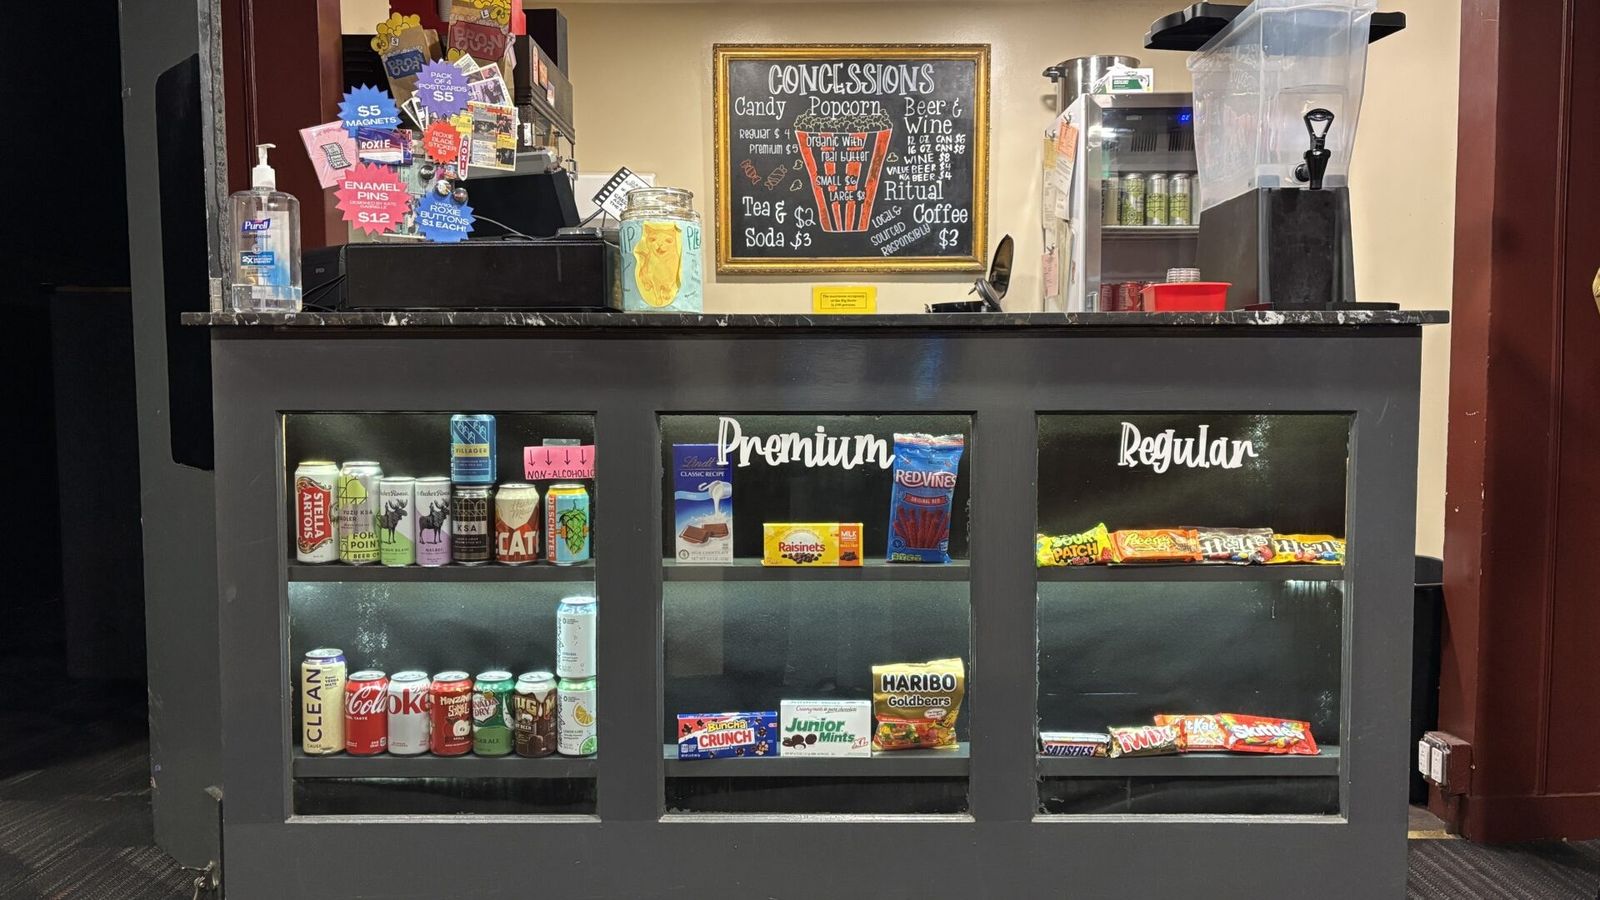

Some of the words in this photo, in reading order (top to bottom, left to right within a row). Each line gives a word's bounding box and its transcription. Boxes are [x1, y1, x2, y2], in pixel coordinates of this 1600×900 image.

[768, 62, 935, 96] CONCESSIONS
[418, 84, 468, 93] POSTCARDS
[433, 91, 454, 102] $5
[357, 105, 381, 117] $5
[735, 96, 787, 120] Candy
[809, 96, 881, 120] Popcorn
[904, 97, 946, 117] Beer
[952, 97, 962, 118] &
[345, 117, 396, 127] MAGNETS
[904, 115, 952, 134] Wine
[739, 128, 771, 140] Regular
[907, 135, 916, 146] 12
[919, 135, 930, 144] OZ
[935, 134, 952, 144] CAN
[954, 133, 966, 144] $6
[361, 139, 392, 149] ROXIE
[428, 142, 458, 152] STICKER
[908, 145, 916, 154] 16
[920, 144, 932, 152] OZ
[935, 144, 952, 152] CAN
[953, 144, 966, 154] $8
[821, 151, 838, 162] real
[840, 150, 870, 162] butter
[904, 153, 934, 165] WINE
[938, 152, 950, 162] $8
[886, 166, 910, 176] VALUE
[911, 164, 936, 174] BEER
[940, 162, 952, 172] $4
[816, 176, 842, 186] SMALL
[912, 174, 936, 182] BEER
[938, 172, 952, 180] $4
[345, 181, 400, 192] ENAMEL
[884, 180, 944, 201] Ritual
[357, 192, 389, 201] PINS
[830, 191, 854, 202] LARGE
[358, 212, 390, 223] $12
[420, 210, 470, 225] BUTTONS
[430, 205, 461, 217] ROXIE
[742, 196, 770, 217] Tea
[775, 200, 787, 224] &
[794, 206, 816, 228] $2
[913, 203, 968, 224] Coffee
[244, 220, 268, 230] Purell
[422, 219, 435, 227] $1
[435, 221, 467, 232] EACH!
[745, 227, 784, 248] Soda
[790, 231, 812, 250] $3
[939, 228, 959, 250] $3
[717, 417, 896, 470] Premium
[1118, 422, 1258, 474] Regular
[683, 456, 715, 468] Lindt
[527, 469, 595, 479] NON-ALCOHOLIC
[303, 492, 314, 538] ARTOIS
[314, 492, 324, 538] STELLA
[547, 496, 556, 558] DESCHUTES
[778, 542, 826, 552] Raisinets
[1053, 534, 1095, 547] SOUR
[1053, 543, 1098, 560] PATCH
[882, 674, 956, 692] HARIBO
[306, 668, 322, 742] CLEAN
[888, 694, 951, 707] Goldbears
[474, 707, 490, 716] DRY
[707, 720, 747, 733] Buncha
[786, 718, 845, 732] Junior
[699, 730, 752, 748] CRUNCH
[818, 732, 856, 743] Mints
[852, 737, 869, 750] XL
[1115, 726, 1176, 754] Twix
[1044, 745, 1094, 756] SATISFIES
